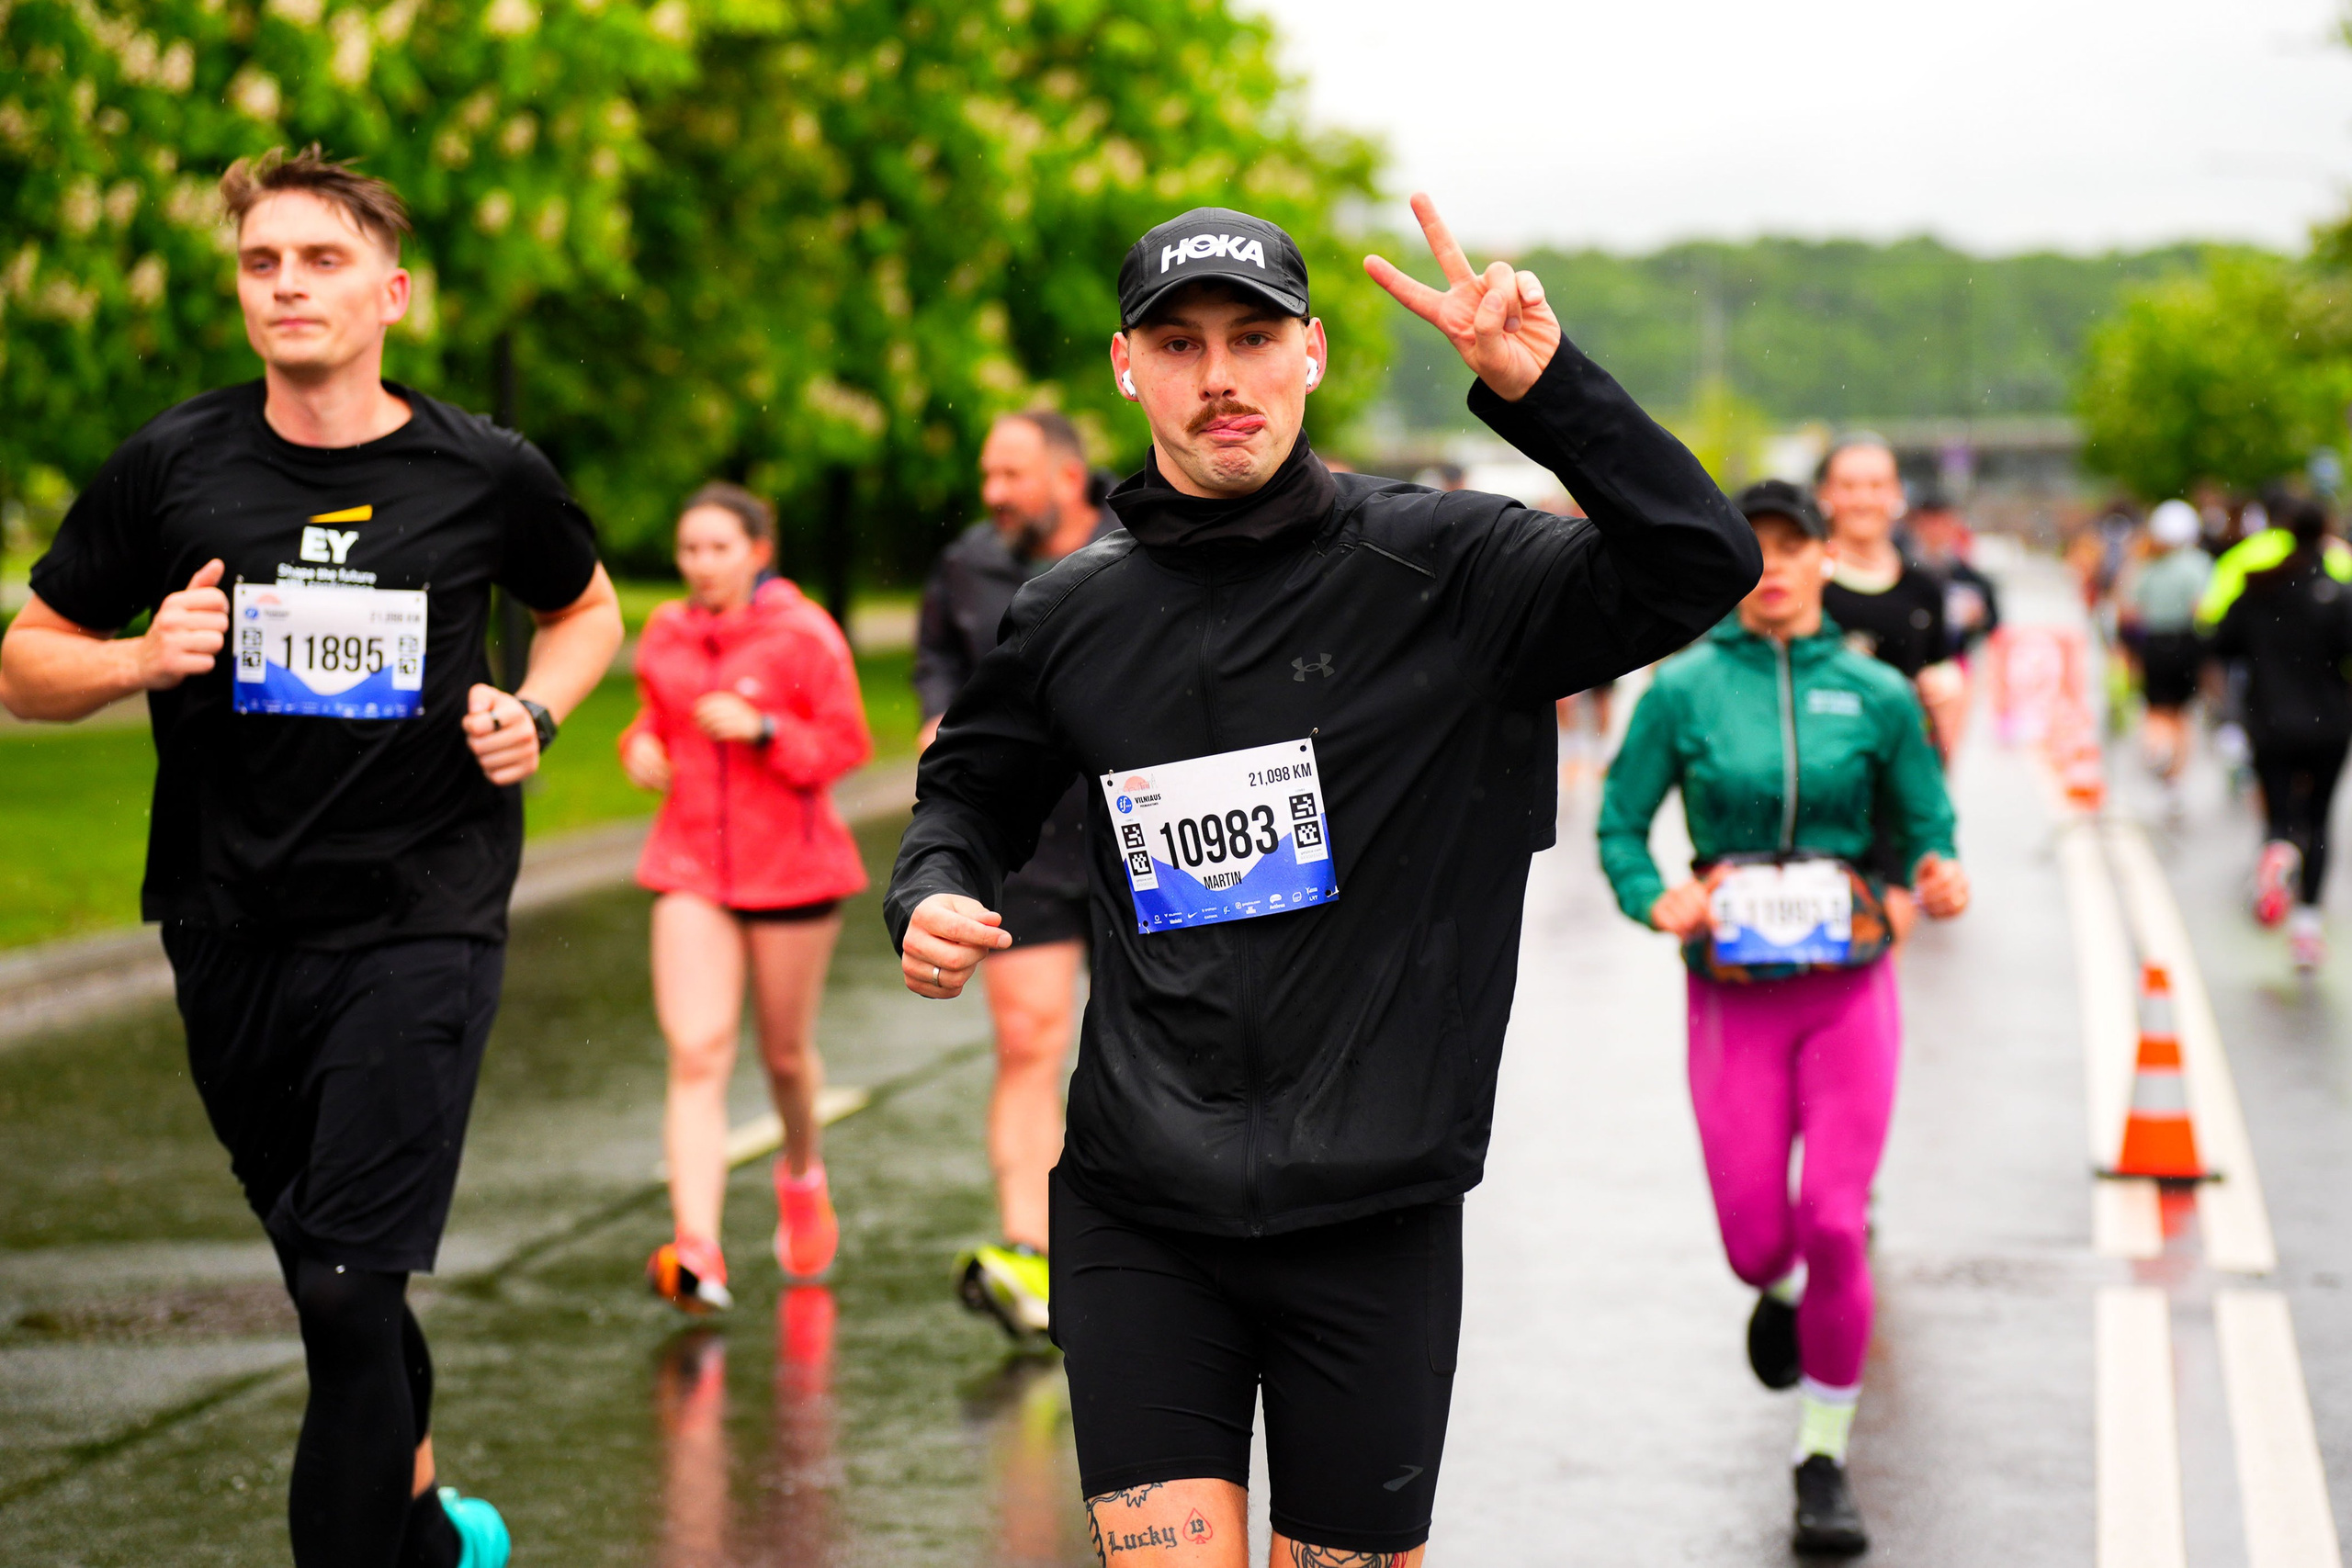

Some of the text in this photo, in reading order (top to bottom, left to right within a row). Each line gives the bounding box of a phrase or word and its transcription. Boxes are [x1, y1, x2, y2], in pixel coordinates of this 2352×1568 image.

[1160, 234, 1266, 274] HOKA
[300, 525, 359, 564] EY
[277, 562, 377, 584] Shape the future
[282, 634, 384, 673] 11895
[1249, 762, 1312, 787] 21,098 KM
[1134, 794, 1161, 804] VILNIAUS
[1159, 805, 1279, 870] 10983
[1204, 870, 1243, 890] MARTIN
[1107, 1525, 1177, 1556] Lucky
